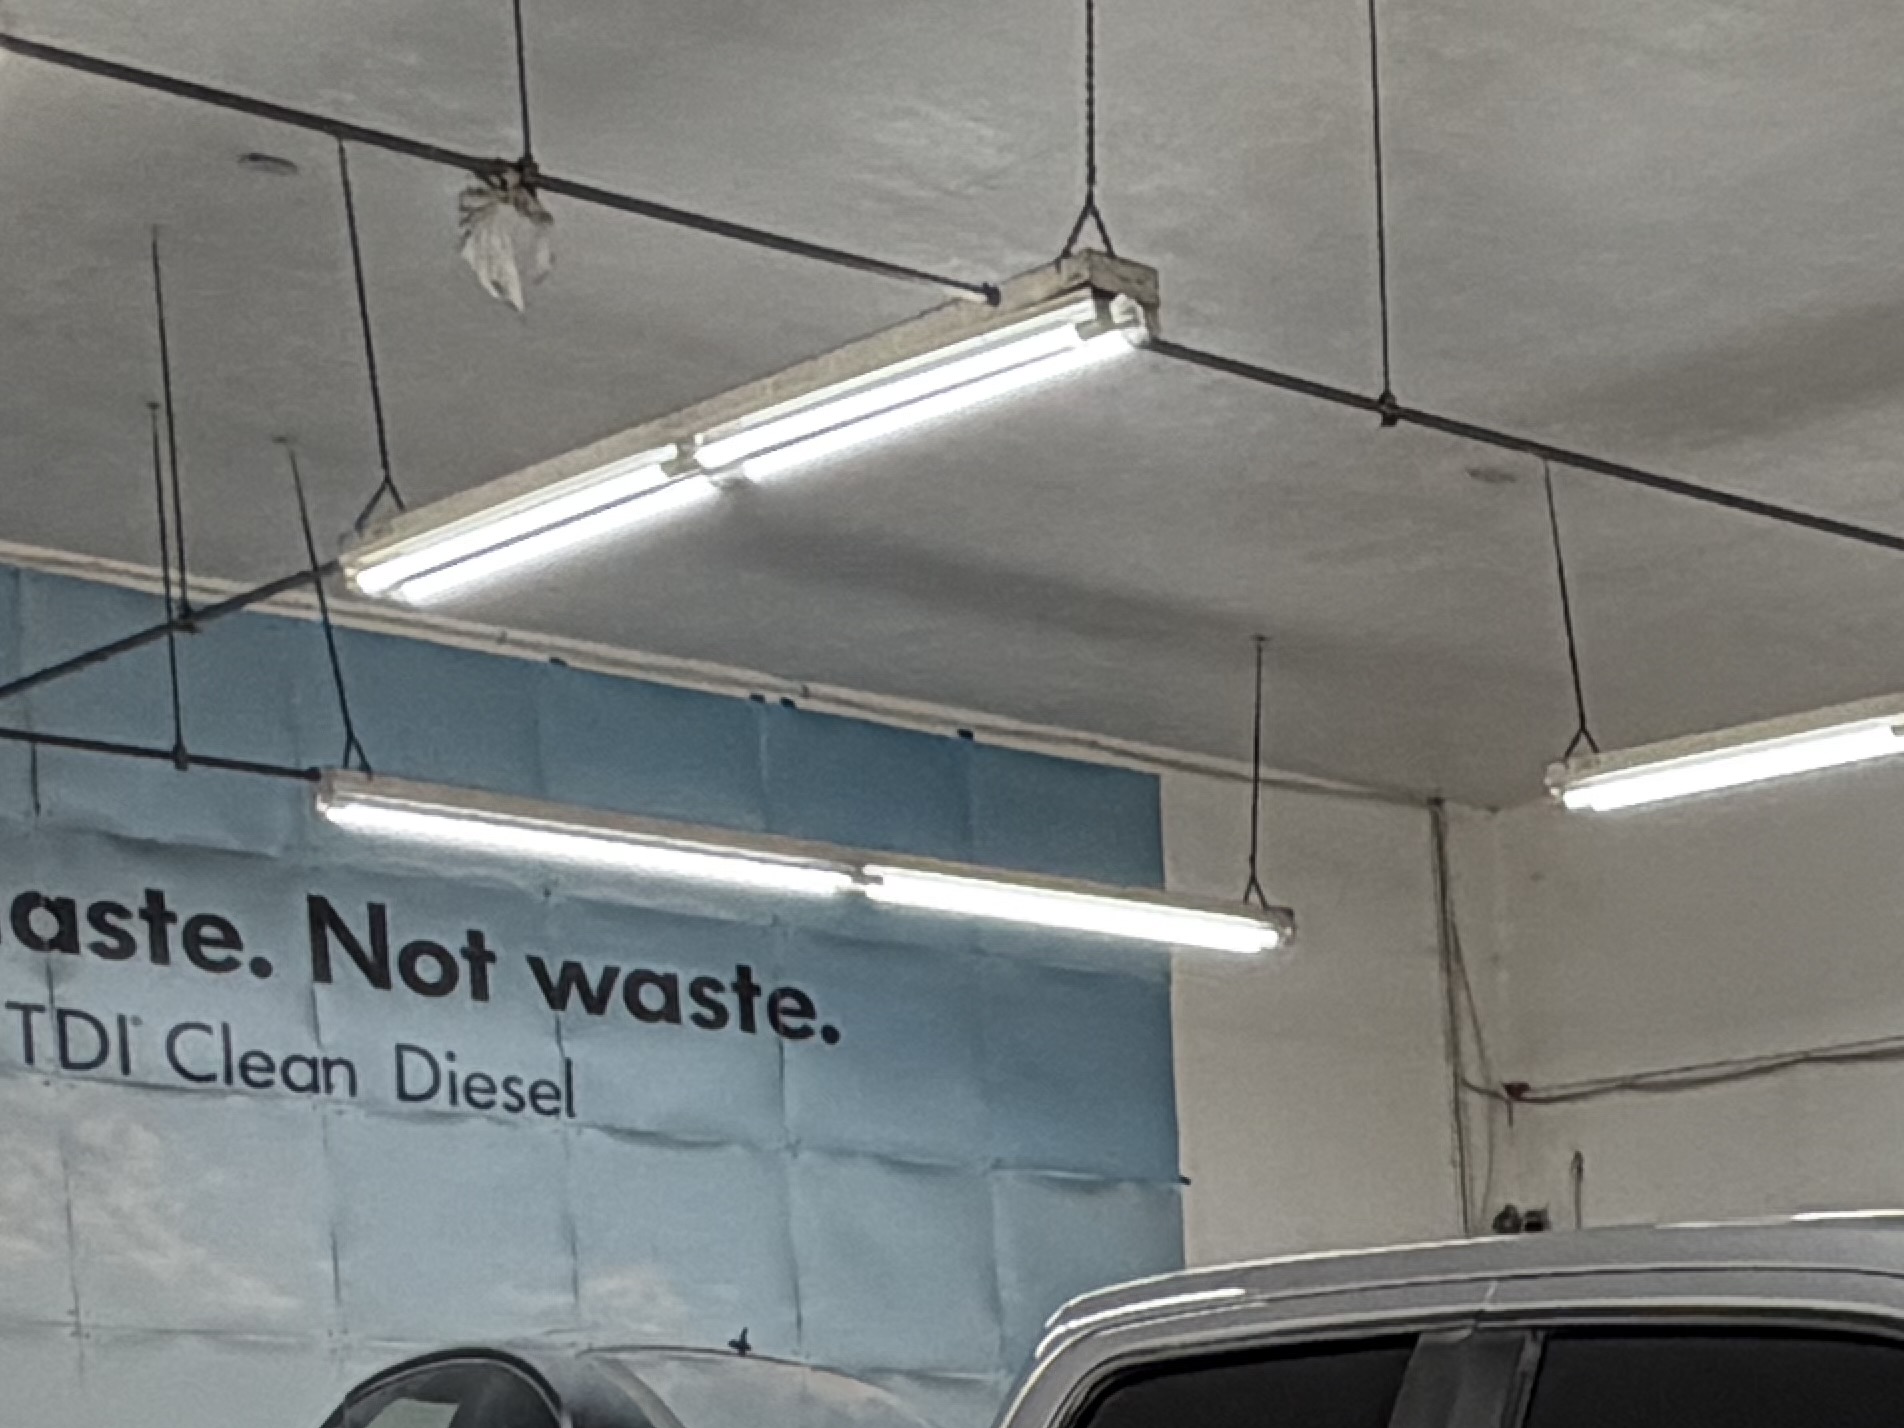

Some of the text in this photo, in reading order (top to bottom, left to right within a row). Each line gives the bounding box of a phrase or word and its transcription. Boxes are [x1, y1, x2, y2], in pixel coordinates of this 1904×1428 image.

[0, 889, 841, 1046] aste. Not waste.
[166, 1020, 358, 1098] Clean
[395, 1043, 577, 1119] Diesel
